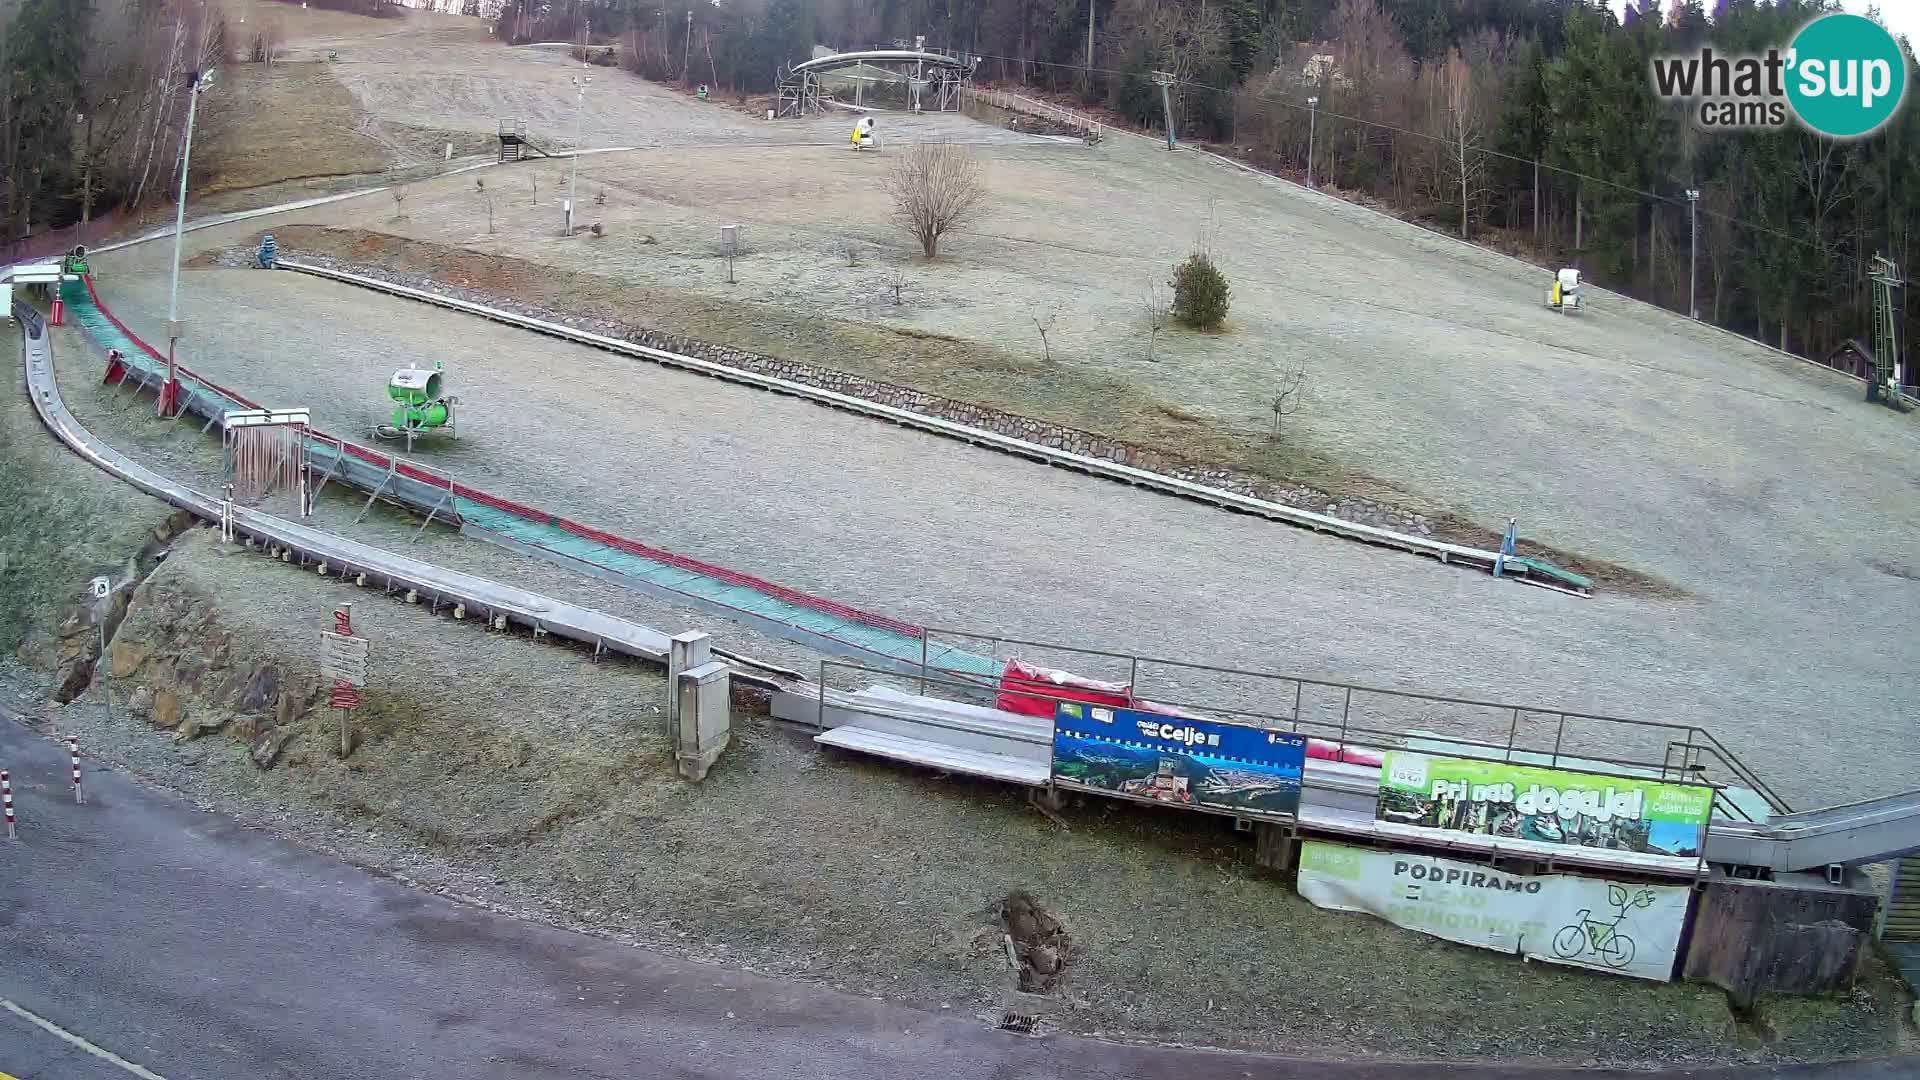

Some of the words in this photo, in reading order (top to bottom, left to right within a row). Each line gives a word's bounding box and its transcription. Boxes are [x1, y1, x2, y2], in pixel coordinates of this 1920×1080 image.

[1159, 724, 1206, 746] Celje
[1430, 778, 1468, 801] Pri
[1471, 782, 1515, 803] nas
[1515, 784, 1644, 822] dogaja!
[1394, 861, 1542, 894] PODPIRAMO
